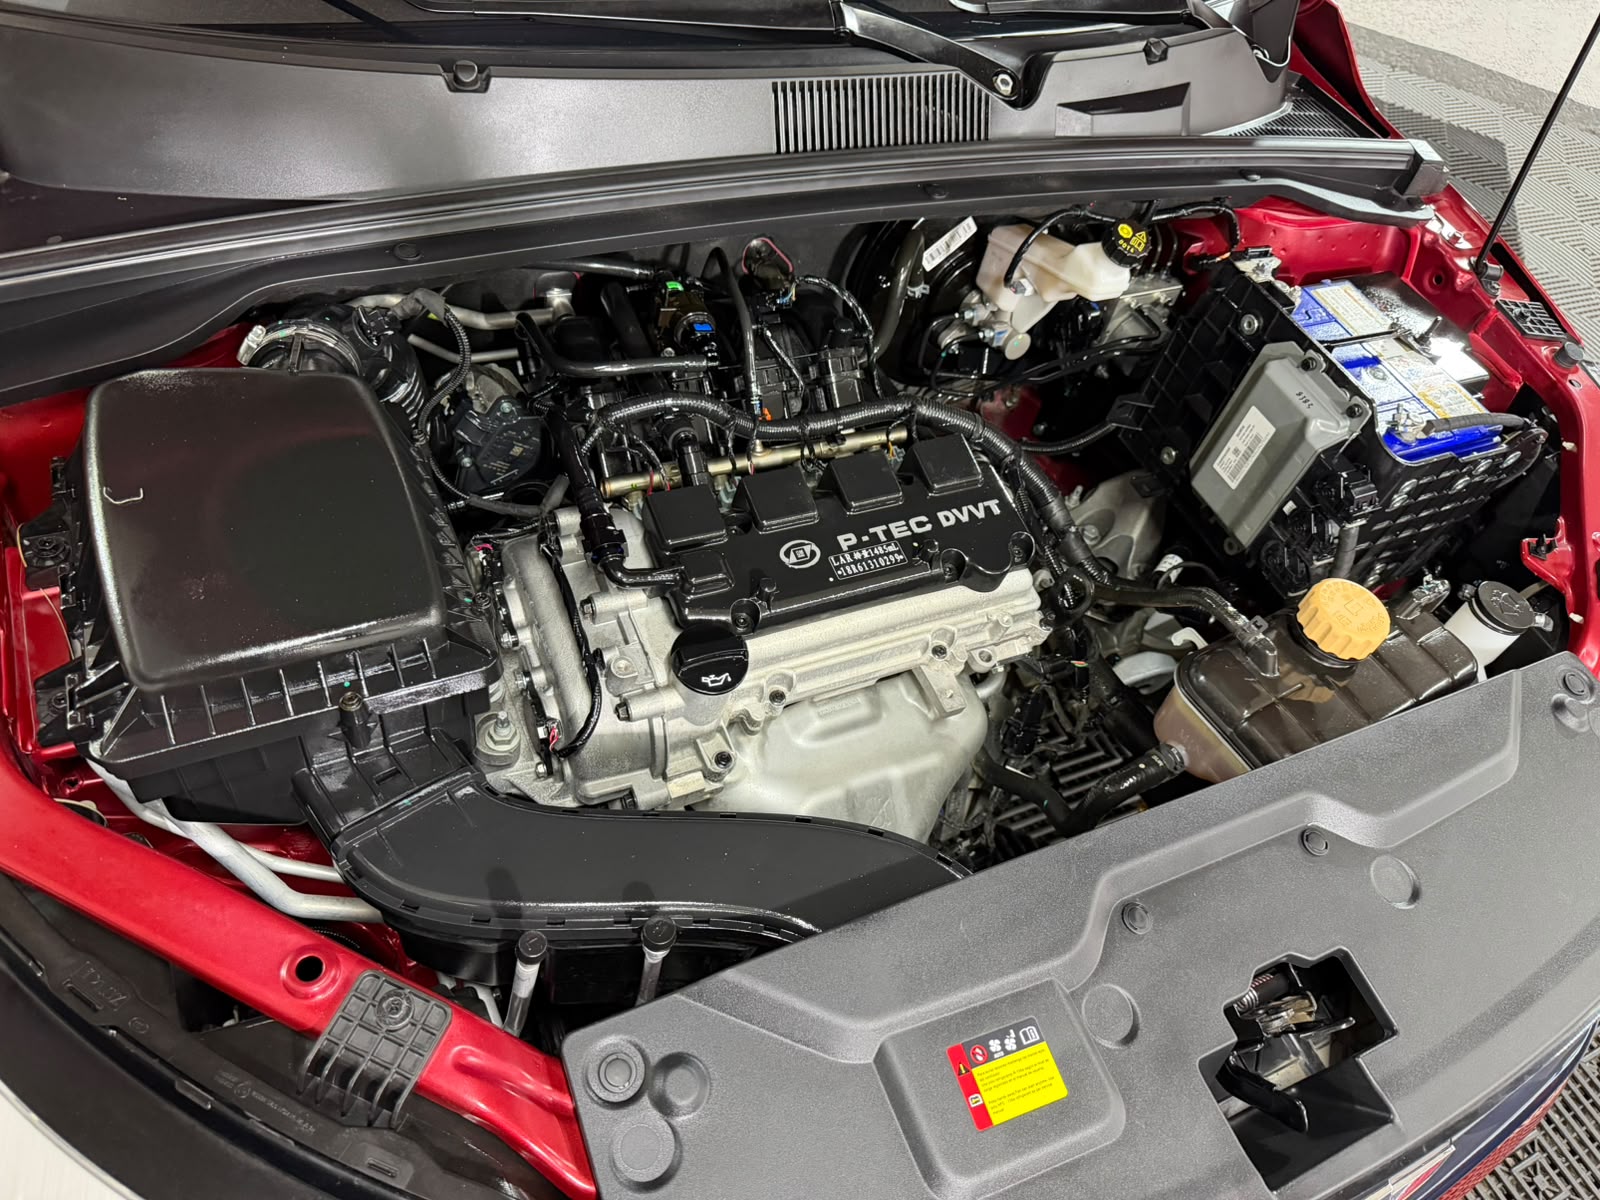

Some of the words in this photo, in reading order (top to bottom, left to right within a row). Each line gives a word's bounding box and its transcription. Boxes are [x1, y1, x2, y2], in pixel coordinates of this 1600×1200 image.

[836, 515, 933, 551] P-TEC
[937, 499, 1001, 528] DVVT
[831, 552, 852, 566] LAR
